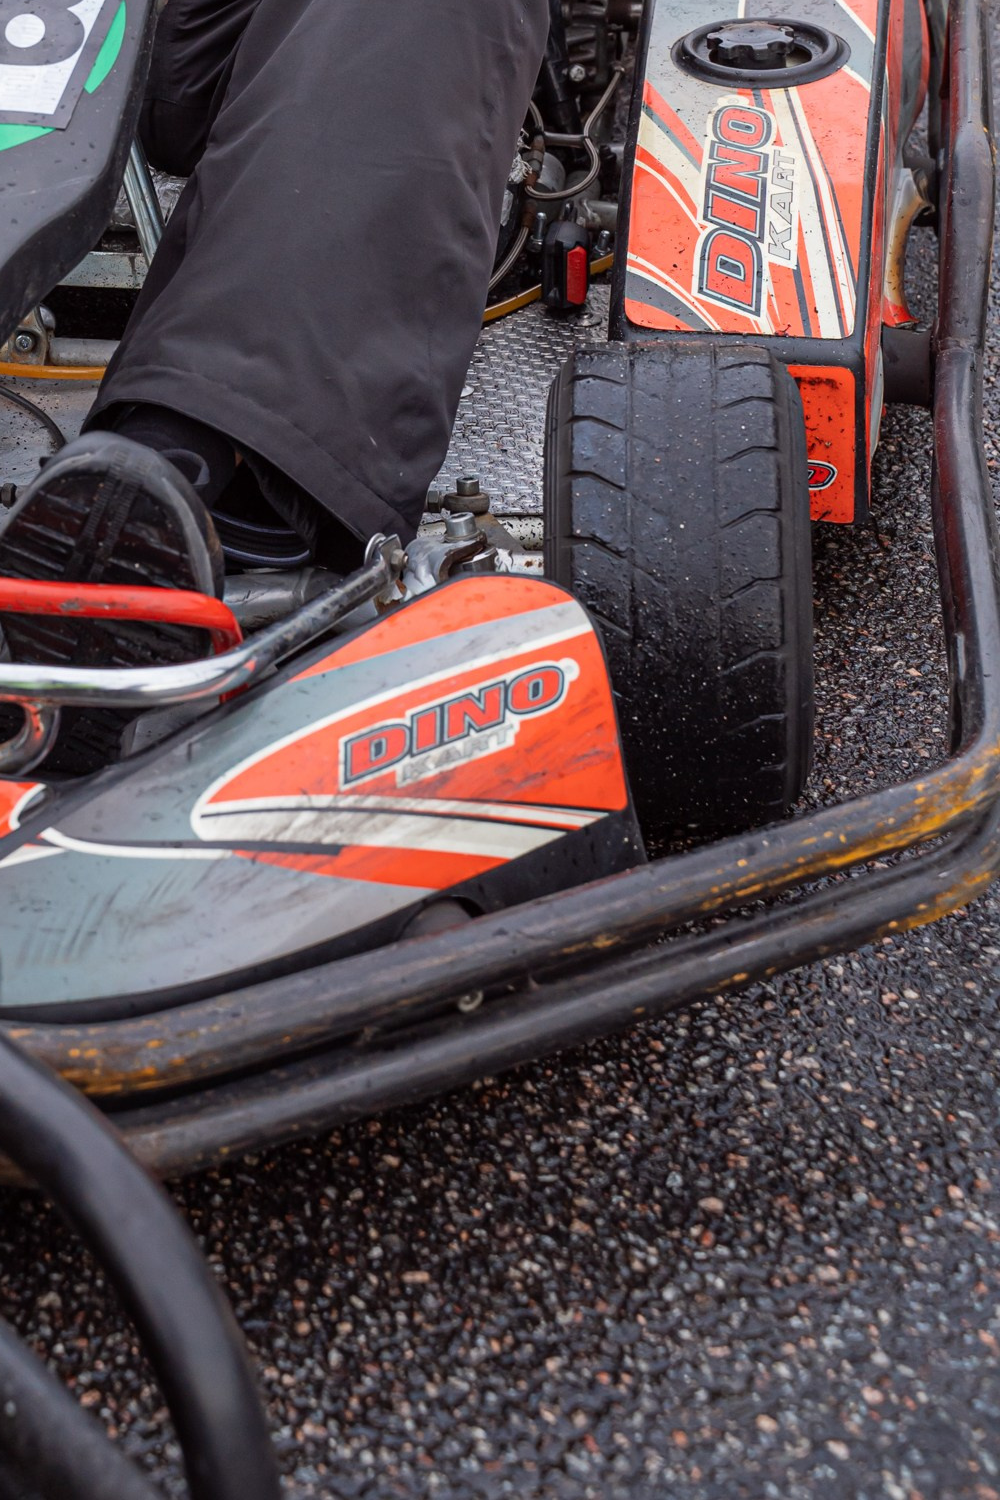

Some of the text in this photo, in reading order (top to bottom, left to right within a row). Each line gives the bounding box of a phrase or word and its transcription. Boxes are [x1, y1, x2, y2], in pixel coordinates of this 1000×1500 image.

[697, 104, 772, 319] DINO
[767, 148, 796, 261] KART
[343, 664, 566, 786] DINO
